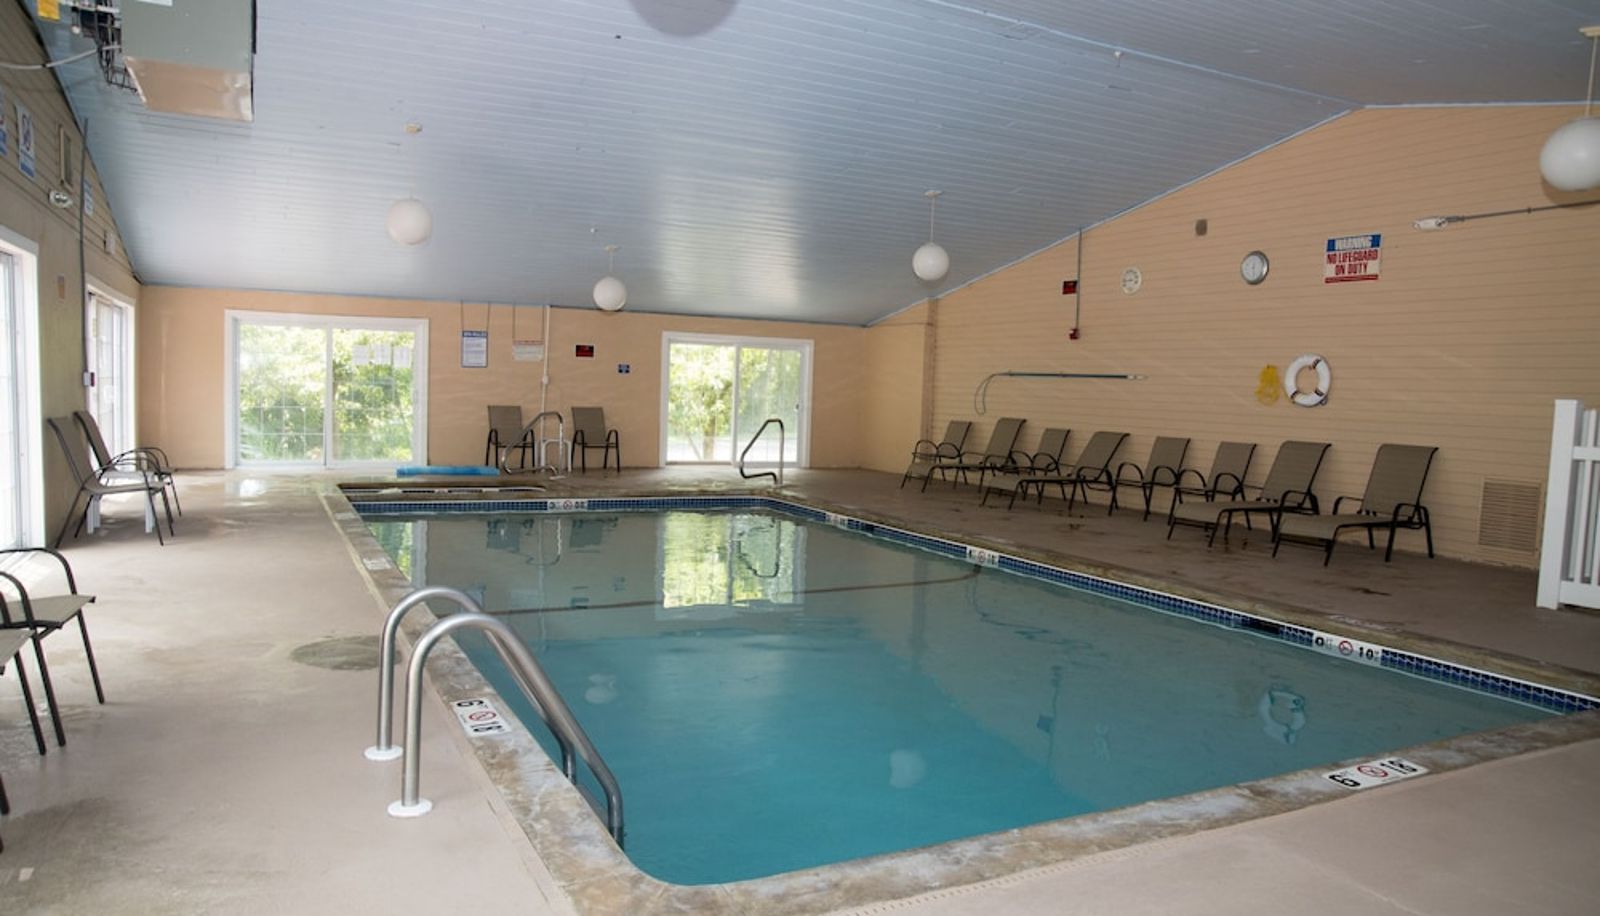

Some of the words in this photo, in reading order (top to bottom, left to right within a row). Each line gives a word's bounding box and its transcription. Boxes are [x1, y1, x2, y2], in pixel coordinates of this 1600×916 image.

[1335, 235, 1372, 250] WARNING
[1327, 253, 1338, 264] NO
[1339, 249, 1378, 263] LIFEGUARD
[1335, 264, 1345, 275] ON
[1348, 262, 1368, 274] DUTY
[1328, 774, 1361, 787] 6
